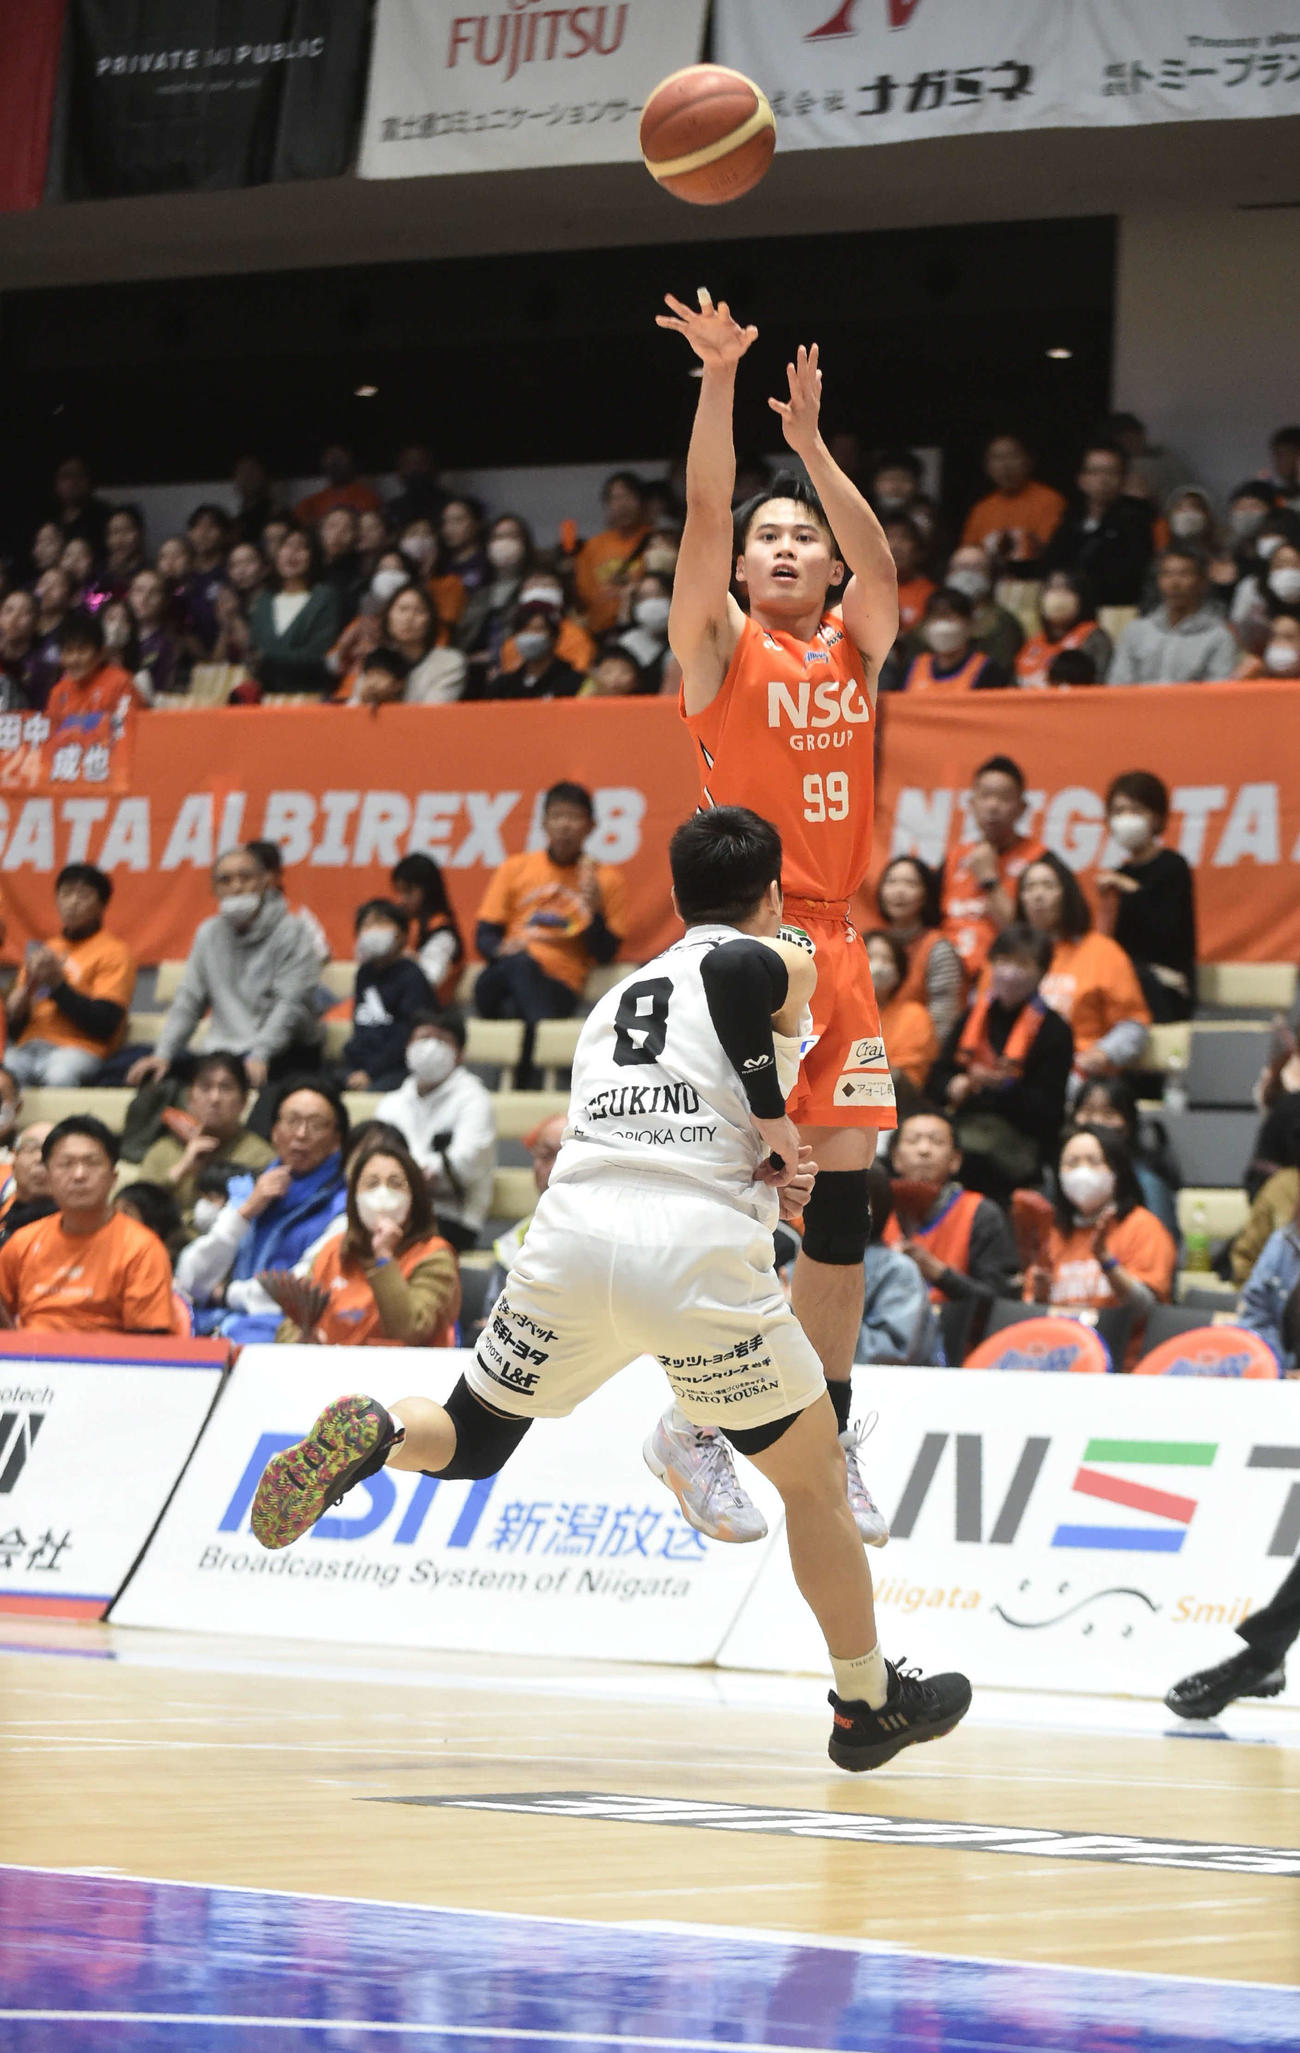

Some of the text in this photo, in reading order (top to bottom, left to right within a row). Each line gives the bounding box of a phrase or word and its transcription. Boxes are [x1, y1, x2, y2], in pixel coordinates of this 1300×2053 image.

[96, 50, 199, 77] PRIVATE
[234, 36, 324, 64] PUBLIC
[447, 3, 629, 83] FUJITSU
[768, 678, 870, 728] NSG
[0, 711, 51, 751] 田中
[789, 730, 854, 751] GROUP
[803, 771, 849, 822] 99
[0, 787, 647, 873] ATA ALBIREX B
[892, 783, 1281, 872] NGTA
[613, 976, 674, 1067] 8
[585, 1082, 700, 1122] SUKINO
[680, 1126, 717, 1143] CITY
[657, 1334, 763, 1368] ネッツトヨタ岩手
[501, 1361, 540, 1388] L&F
[688, 1393, 720, 1404] SATO
[723, 1380, 779, 1404] KOUSAN
[487, 1501, 707, 1561] 新潟放送
[198, 1546, 691, 1602] Broadcasting System of Niigata
[1172, 1595, 1256, 1625] Smil
